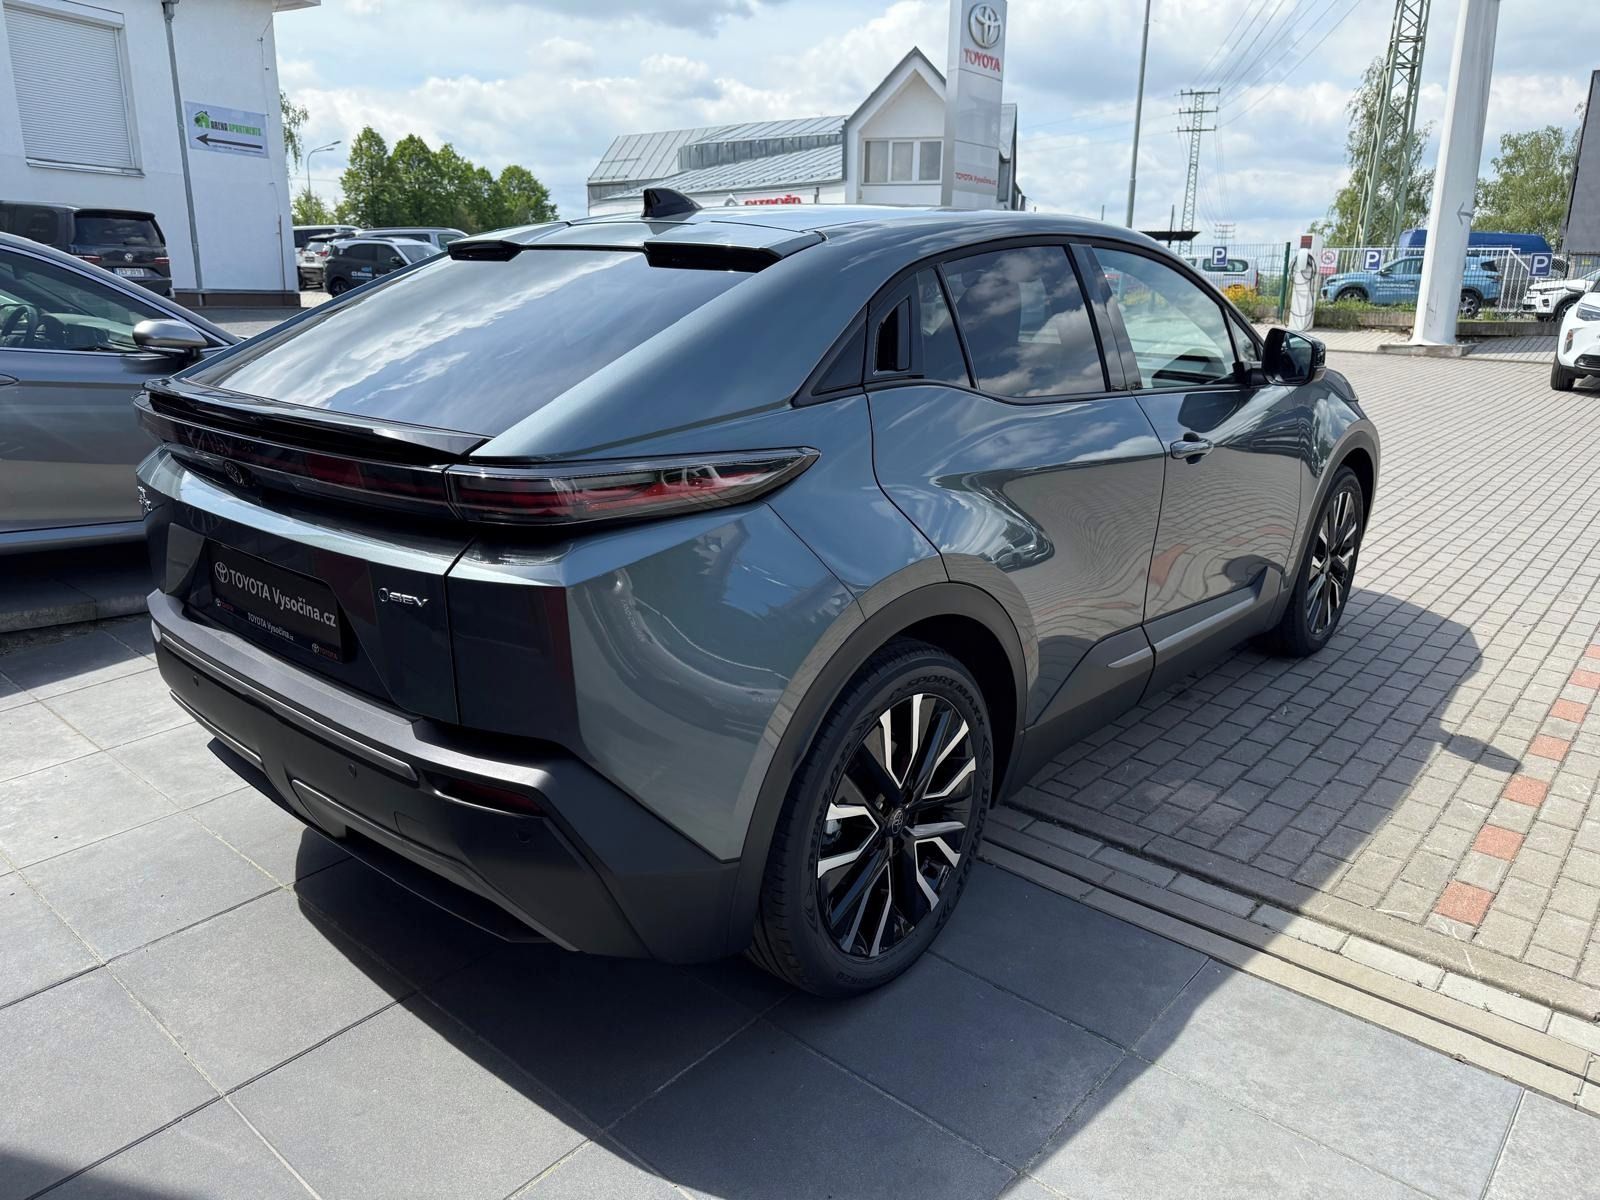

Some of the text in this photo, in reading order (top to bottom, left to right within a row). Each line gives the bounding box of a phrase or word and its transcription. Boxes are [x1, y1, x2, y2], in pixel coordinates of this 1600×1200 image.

[963, 48, 1001, 72] TOYOTA
[955, 172, 973, 182] TOYOTA
[1213, 247, 1225, 264] P
[1365, 251, 1379, 269] P
[1532, 255, 1549, 275] P
[229, 569, 337, 628] TOYOTA Vysočina.cz
[247, 612, 267, 629] TOYOTA
